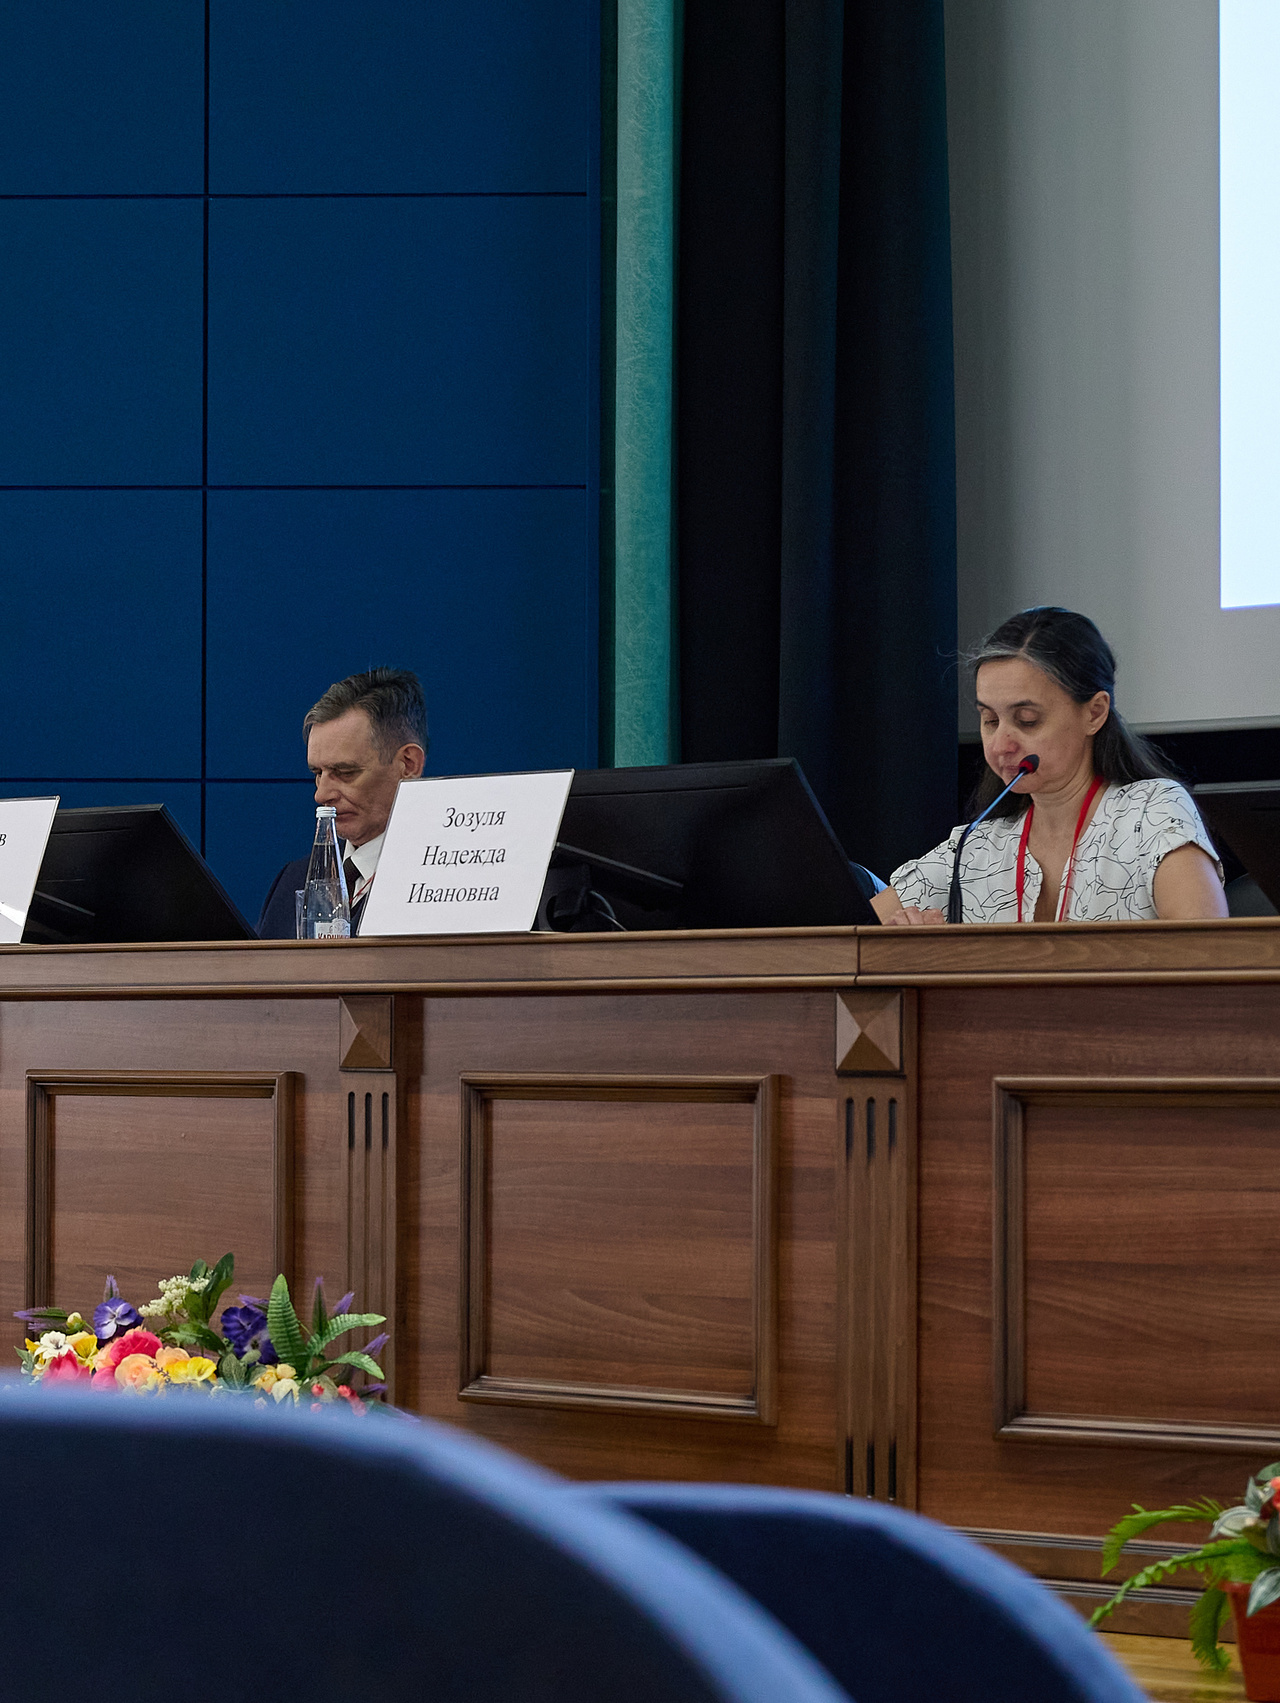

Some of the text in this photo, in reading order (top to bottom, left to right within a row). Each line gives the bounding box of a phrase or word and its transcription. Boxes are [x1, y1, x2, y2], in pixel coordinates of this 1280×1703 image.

[442, 807, 506, 833] Зозуля
[421, 845, 506, 868] Надежда
[407, 883, 500, 904] Ивановна
